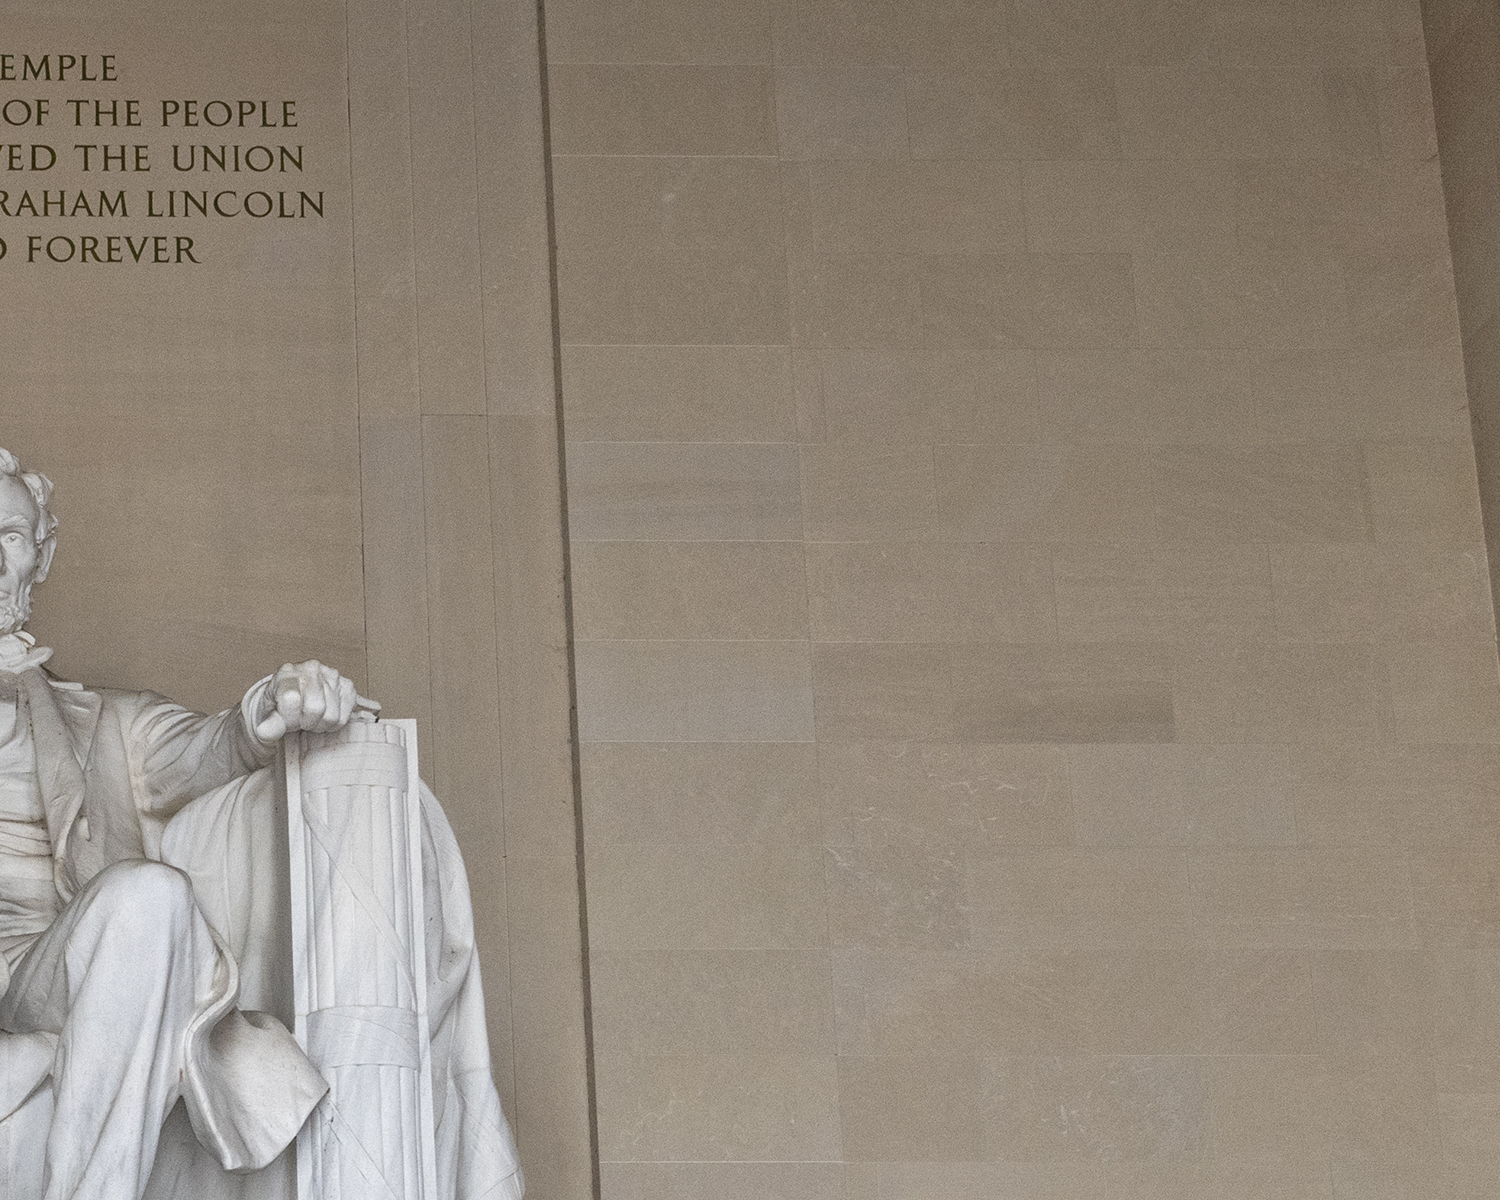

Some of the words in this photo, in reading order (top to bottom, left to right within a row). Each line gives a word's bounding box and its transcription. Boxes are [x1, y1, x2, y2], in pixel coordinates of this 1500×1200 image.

[1, 98, 50, 127] OF
[66, 99, 142, 127] THE
[161, 99, 298, 128] PEOPLE
[73, 144, 151, 172] THE
[172, 144, 303, 173] UNION
[146, 190, 324, 219] LINCOLN
[27, 235, 202, 265] FOREVER
